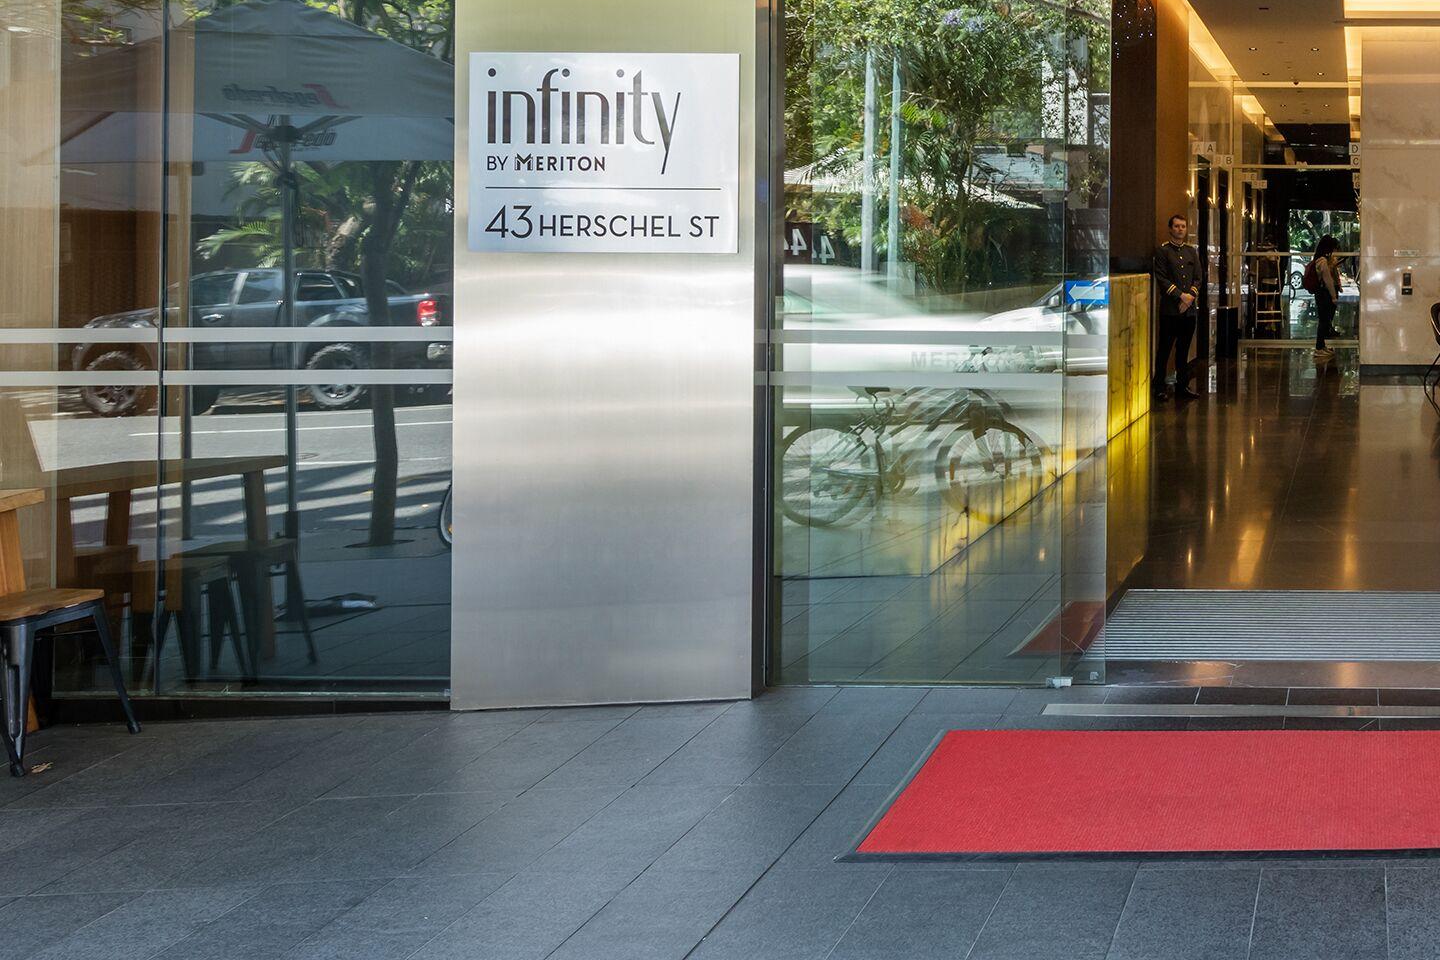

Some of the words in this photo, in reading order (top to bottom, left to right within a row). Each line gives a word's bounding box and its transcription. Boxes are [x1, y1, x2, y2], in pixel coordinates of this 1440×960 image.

[487, 68, 681, 175] infinity
[486, 155, 508, 171] BY
[514, 153, 606, 172] MERITON
[485, 205, 533, 239] 43
[539, 214, 680, 238] HERSCHEL
[688, 215, 719, 238] ST
